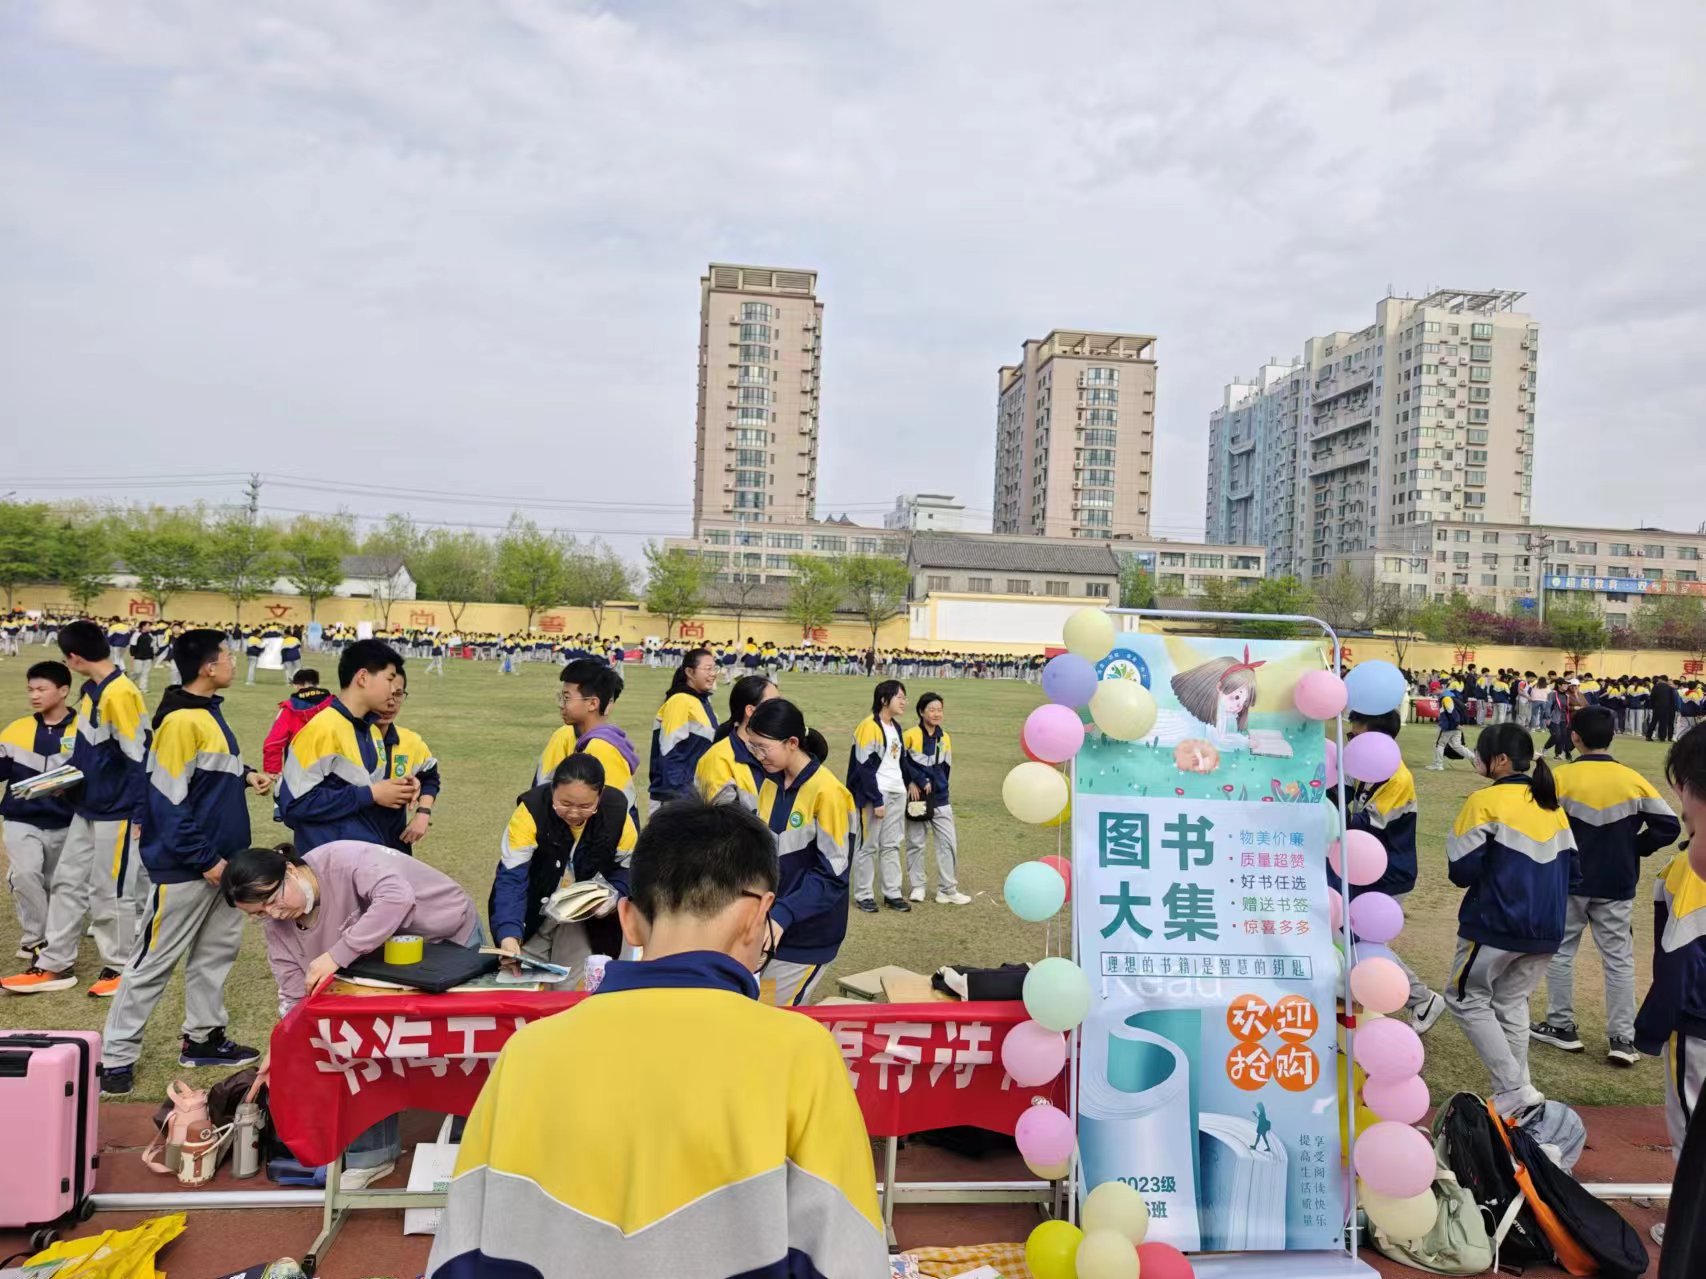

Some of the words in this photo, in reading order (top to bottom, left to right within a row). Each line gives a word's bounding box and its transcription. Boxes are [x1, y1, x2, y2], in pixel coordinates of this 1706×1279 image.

[129, 599, 156, 616] 尚
[265, 603, 293, 619] 文
[410, 609, 435, 626] 尚
[680, 621, 704, 638] 尚
[1682, 659, 1705, 676] 更
[1099, 812, 1215, 871] 图书
[1240, 830, 1305, 847] 物美价廉
[1240, 852, 1305, 869] 质量超赞
[1241, 874, 1307, 891] 好书任选
[1100, 881, 1220, 942] 大集
[1242, 897, 1309, 913] 赠送书签
[1244, 920, 1311, 936] 惊喜多多
[1232, 1000, 1312, 1038] 欢迎
[310, 1016, 526, 1095] 书海无
[1230, 1047, 1312, 1085] 抢购
[1299, 1133, 1313, 1227] 提高生活质量
[1313, 1135, 1327, 1227] 享受阅读快乐
